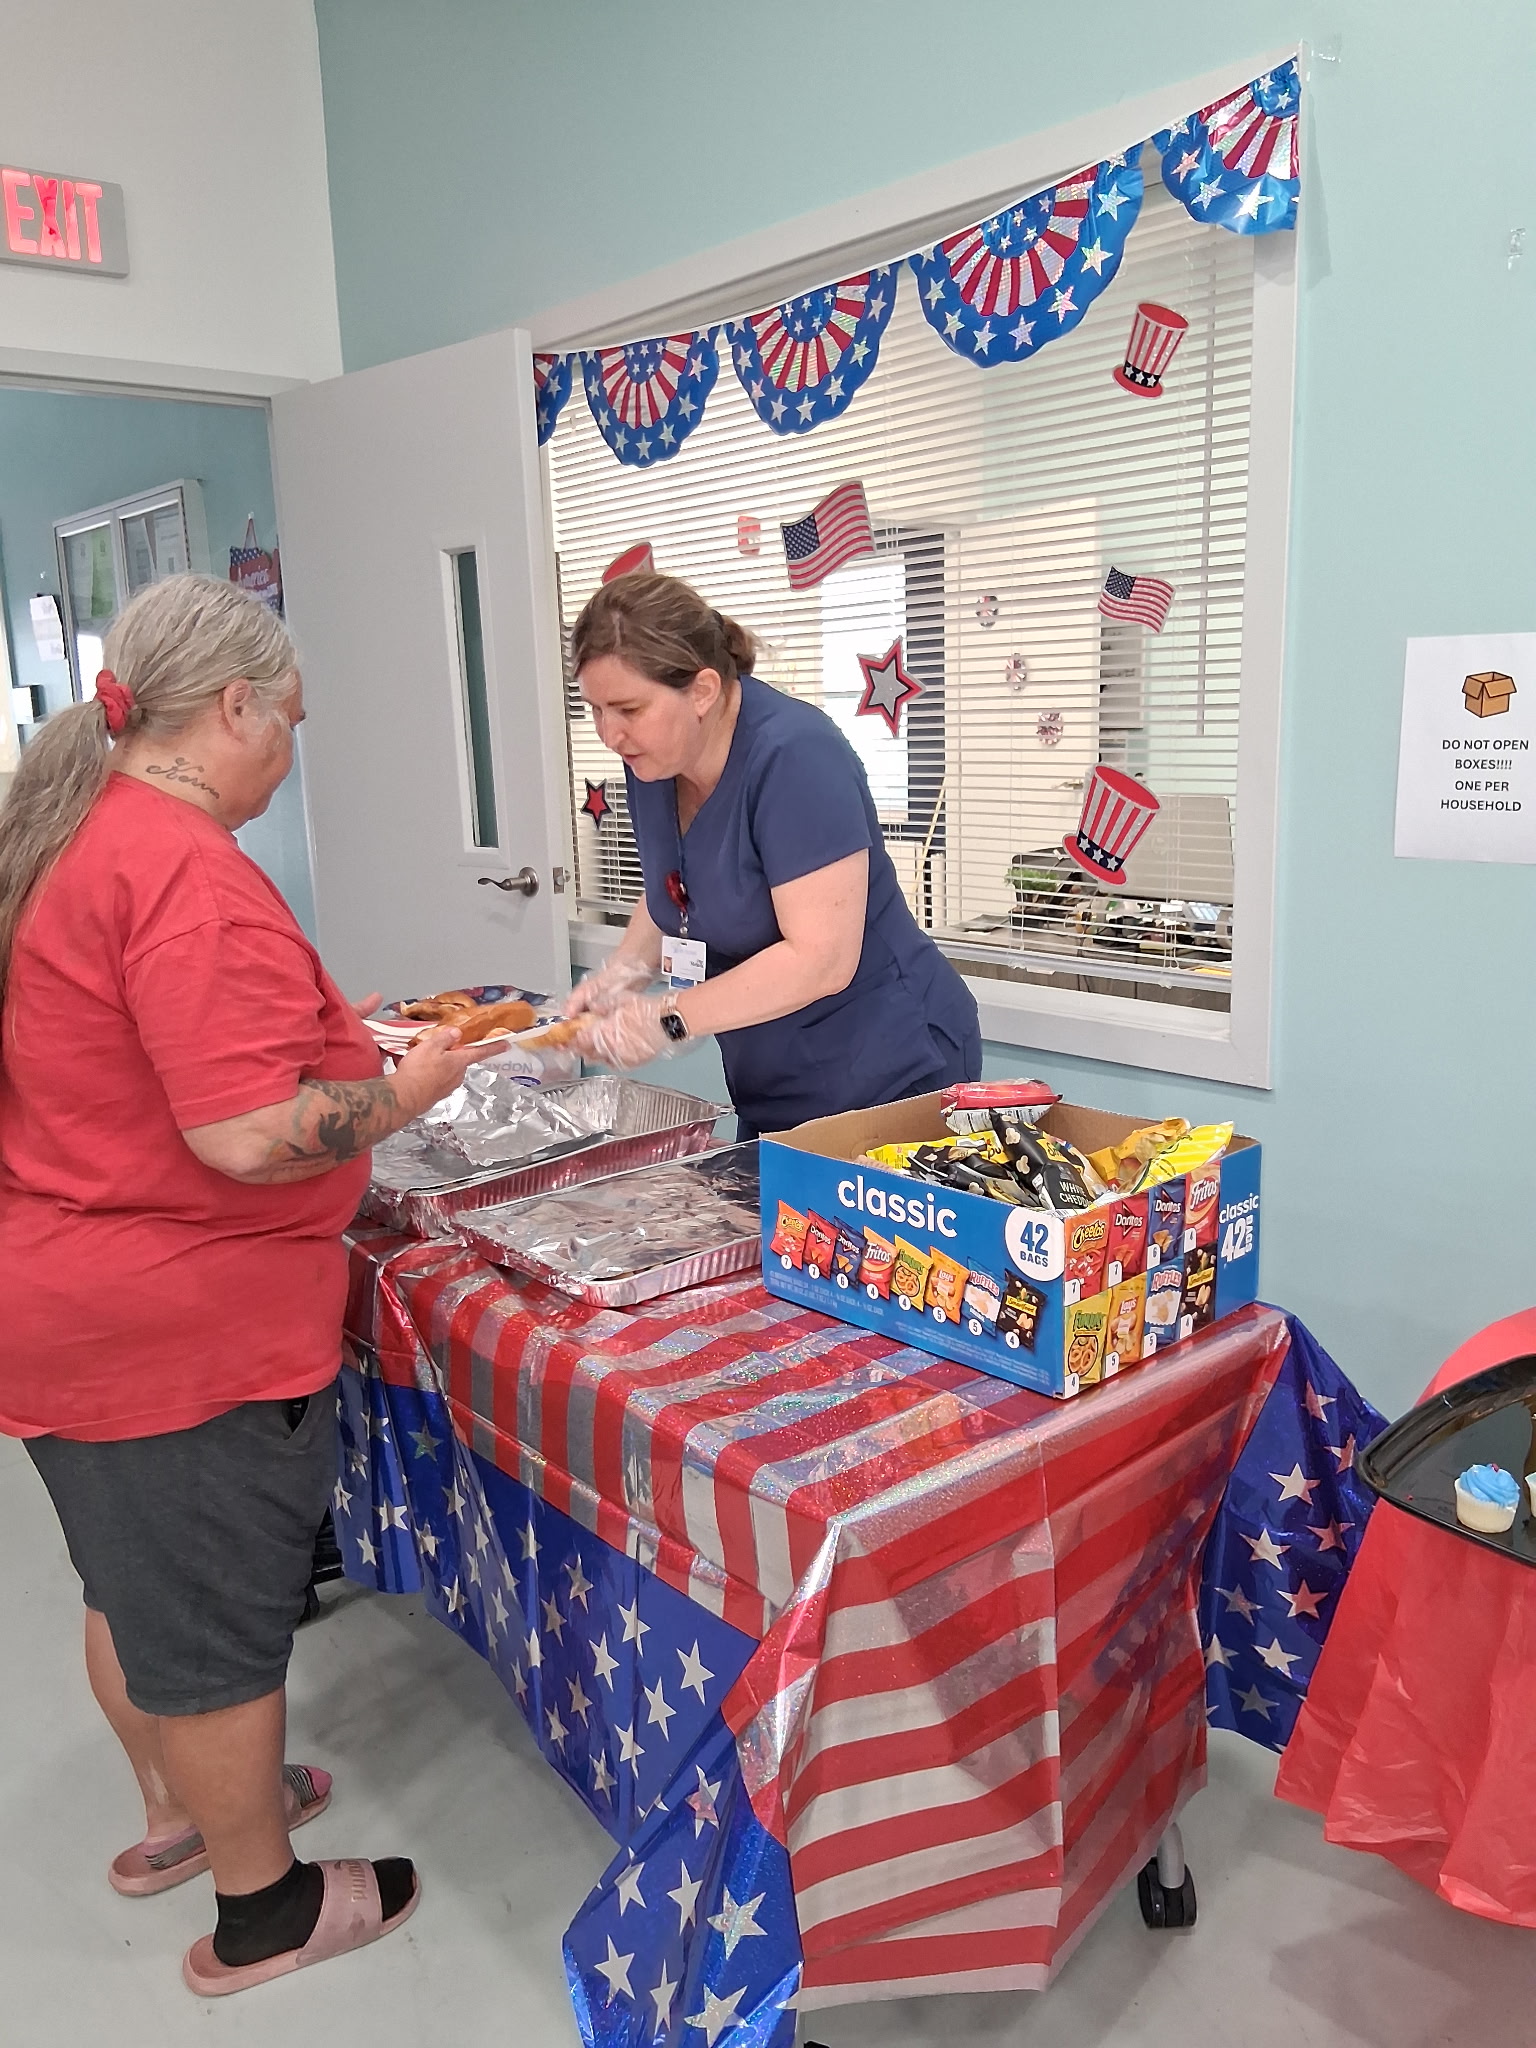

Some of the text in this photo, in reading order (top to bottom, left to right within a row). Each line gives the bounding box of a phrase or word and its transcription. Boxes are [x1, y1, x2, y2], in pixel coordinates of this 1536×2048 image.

[2, 169, 103, 263] EXIT
[1442, 739, 1529, 751] DO NOT OPEN
[1455, 759, 1513, 770] BOXES!!!!
[1455, 780, 1510, 792] ONE PER
[1441, 799, 1522, 812] HOUSEHOLD
[1189, 1178, 1219, 1211] Fritos
[837, 1174, 957, 1239] classic
[1155, 1199, 1181, 1213] Doritos
[1219, 1193, 1260, 1224] classic
[781, 1214, 805, 1232] Cheetos
[1115, 1214, 1143, 1227] Doritos
[810, 1225, 832, 1245] Doritos
[837, 1233, 860, 1254] Doritos
[1020, 1220, 1049, 1256] 42
[1072, 1219, 1107, 1252] Cheetos
[1220, 1217, 1246, 1263] 42
[1245, 1214, 1254, 1253] BAGS
[864, 1241, 892, 1263] Fritos
[1020, 1250, 1049, 1268] BAGS
[969, 1270, 1000, 1297] RUFFLES
